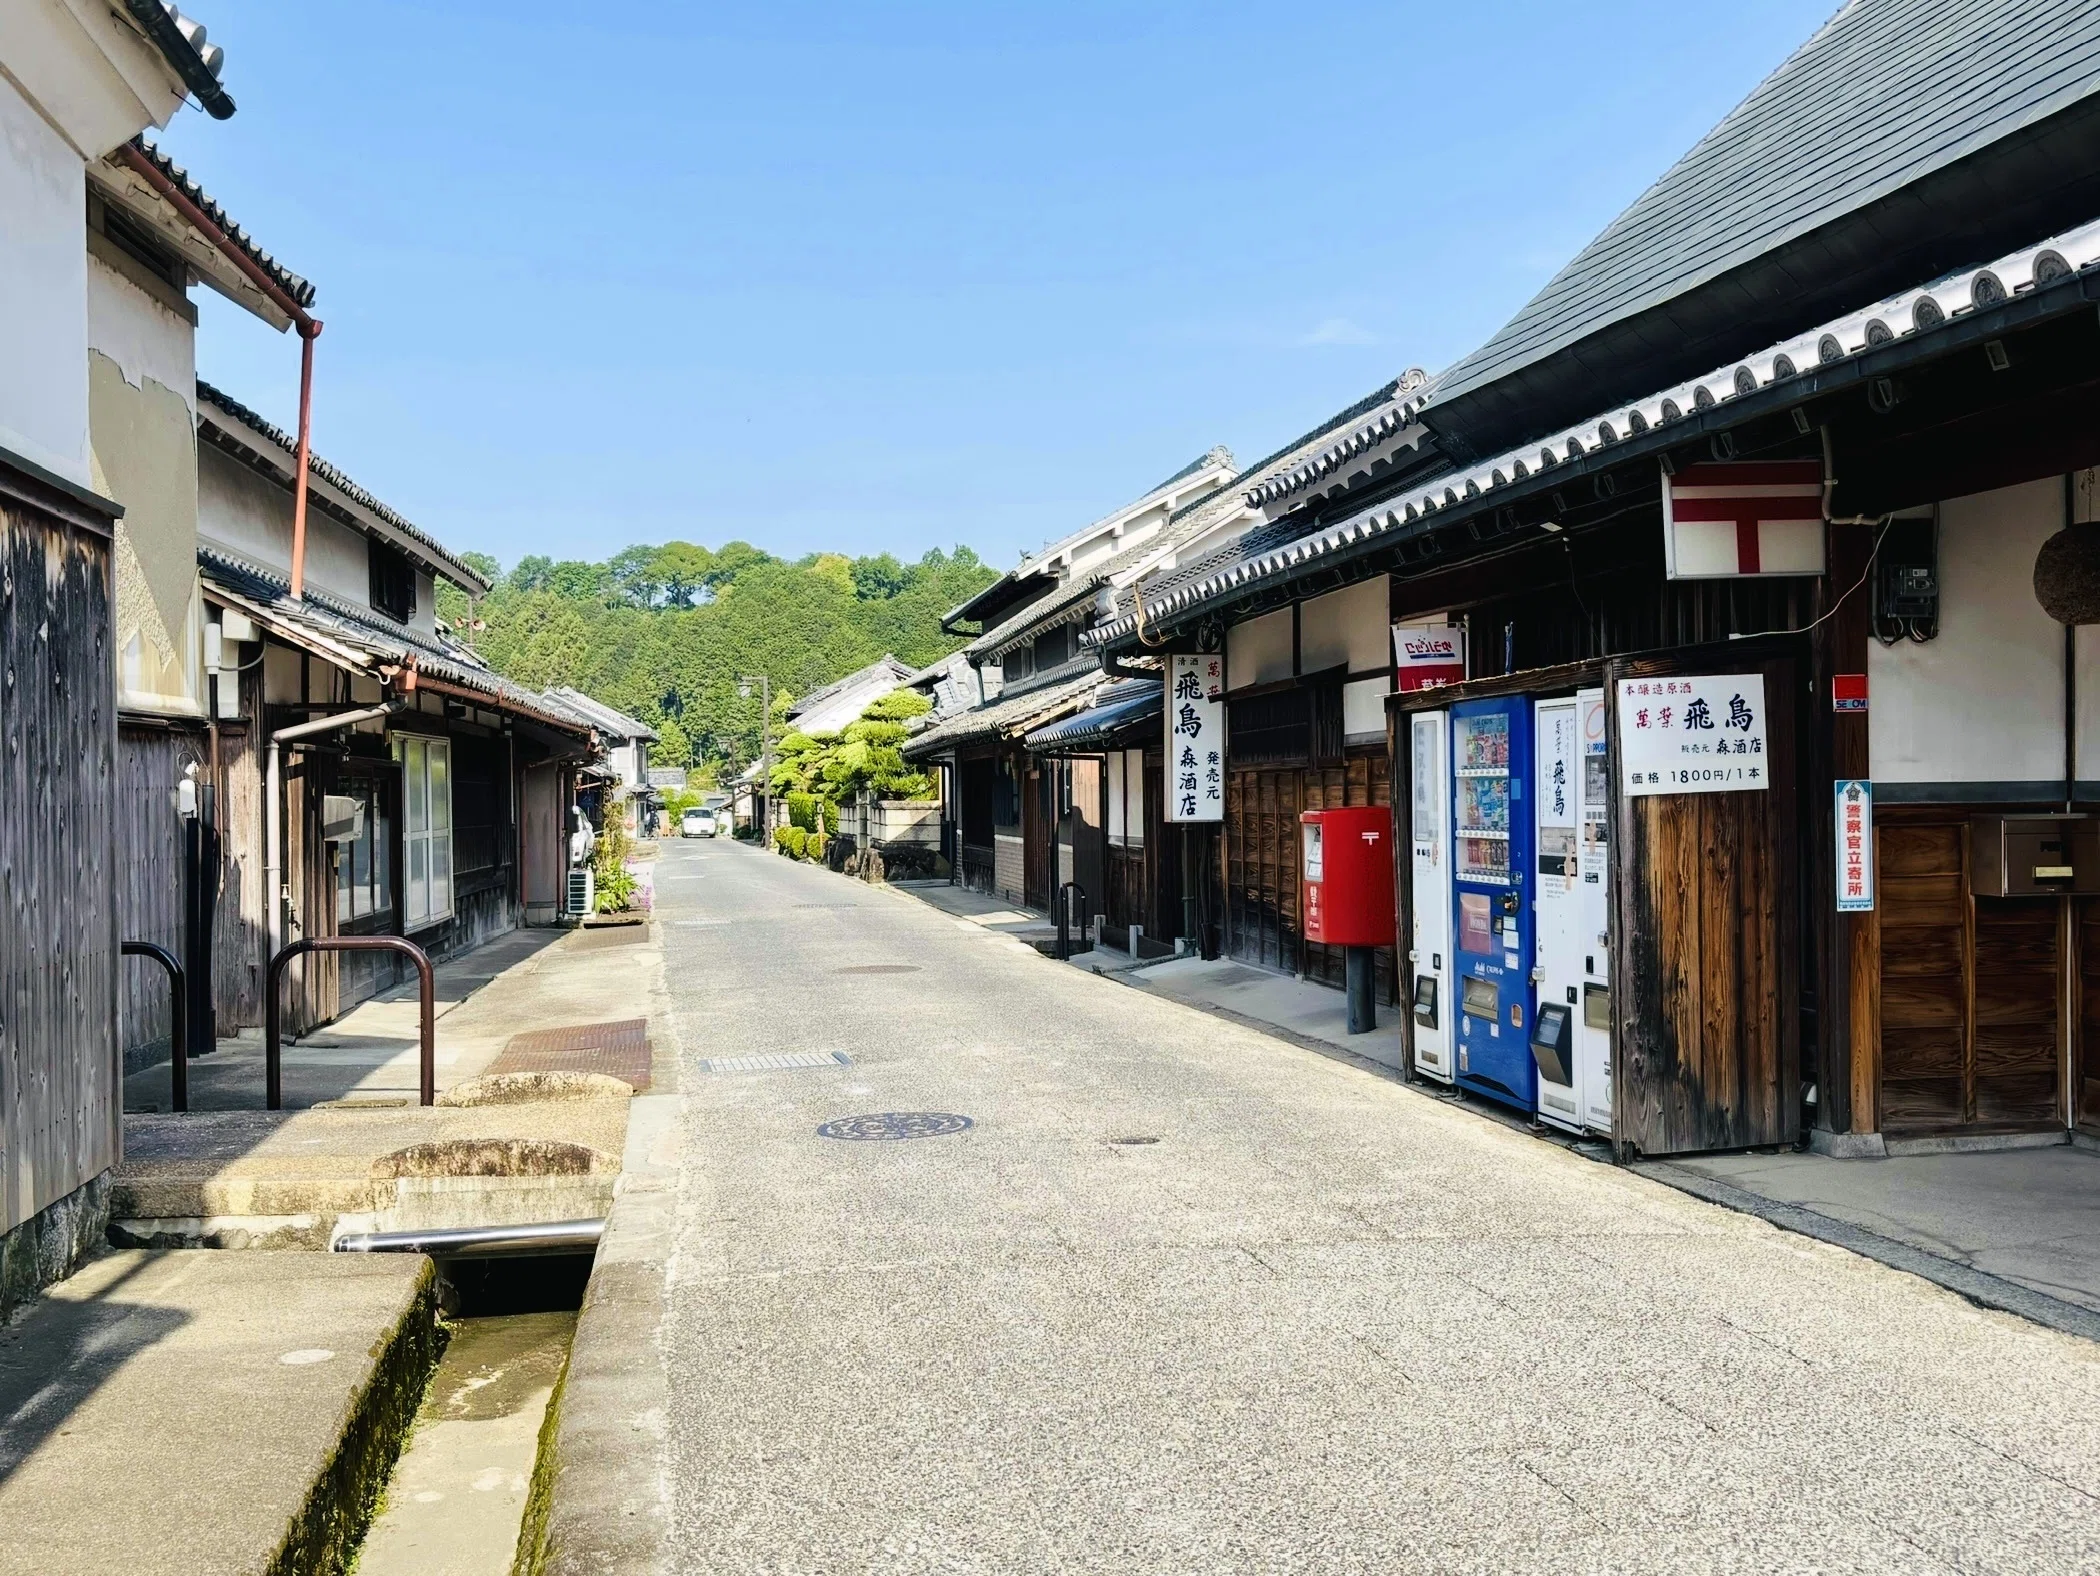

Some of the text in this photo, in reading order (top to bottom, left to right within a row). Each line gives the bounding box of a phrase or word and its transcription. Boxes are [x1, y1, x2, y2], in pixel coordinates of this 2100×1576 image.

[1178, 657, 1199, 666] 清酒
[1174, 670, 1204, 739] 飛鳥
[1624, 682, 1692, 696] 本醸造原酒
[1636, 693, 1754, 732] 萬葉 飛鳥
[1681, 737, 1762, 755] 販売元 森酒店
[1179, 745, 1198, 817] 森酒店
[1206, 751, 1220, 800] 発売元
[1552, 759, 1566, 817] 飛鳥
[1631, 772, 1660, 784] 価格
[1846, 804, 1862, 896] 警察官立寄所
